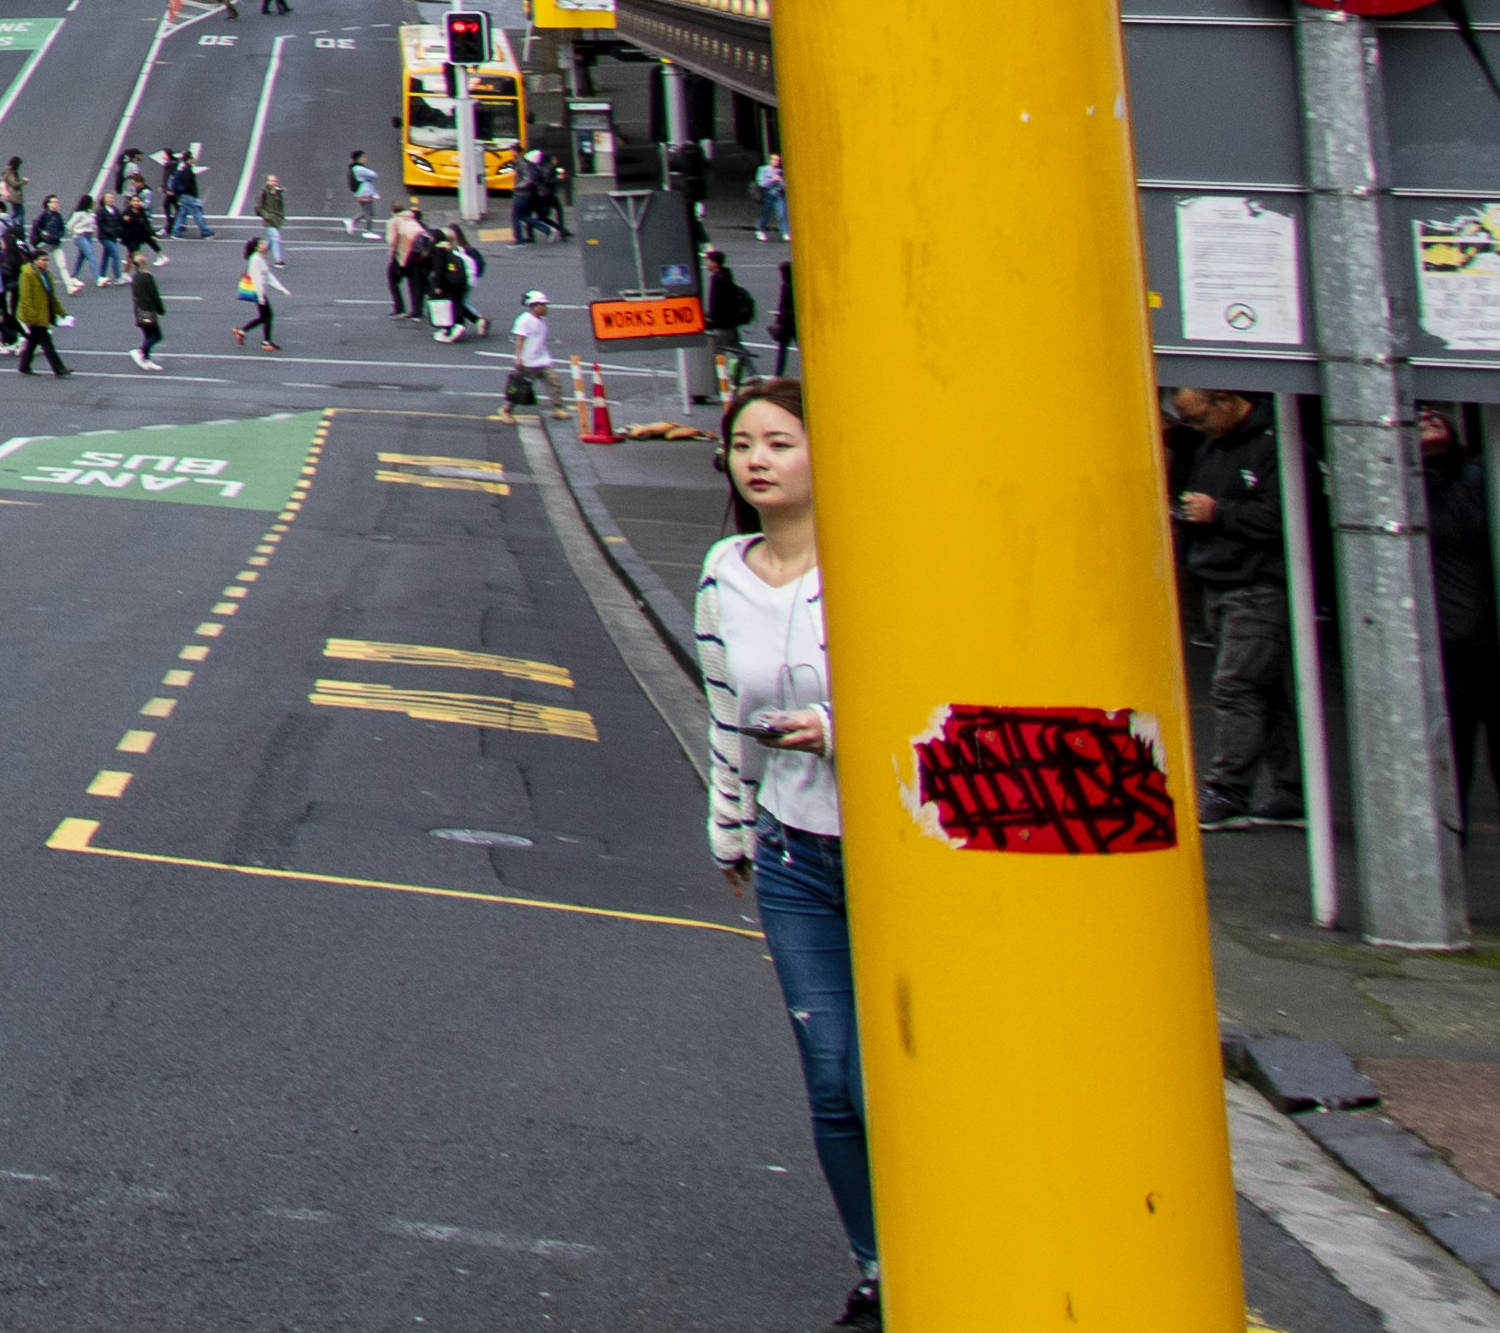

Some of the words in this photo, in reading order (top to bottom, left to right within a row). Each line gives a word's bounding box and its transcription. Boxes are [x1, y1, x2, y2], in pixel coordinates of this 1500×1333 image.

[602, 309, 655, 329] WORKS
[663, 306, 694, 325] END
[71, 451, 230, 475] BUS
[20, 465, 246, 499] LANE
